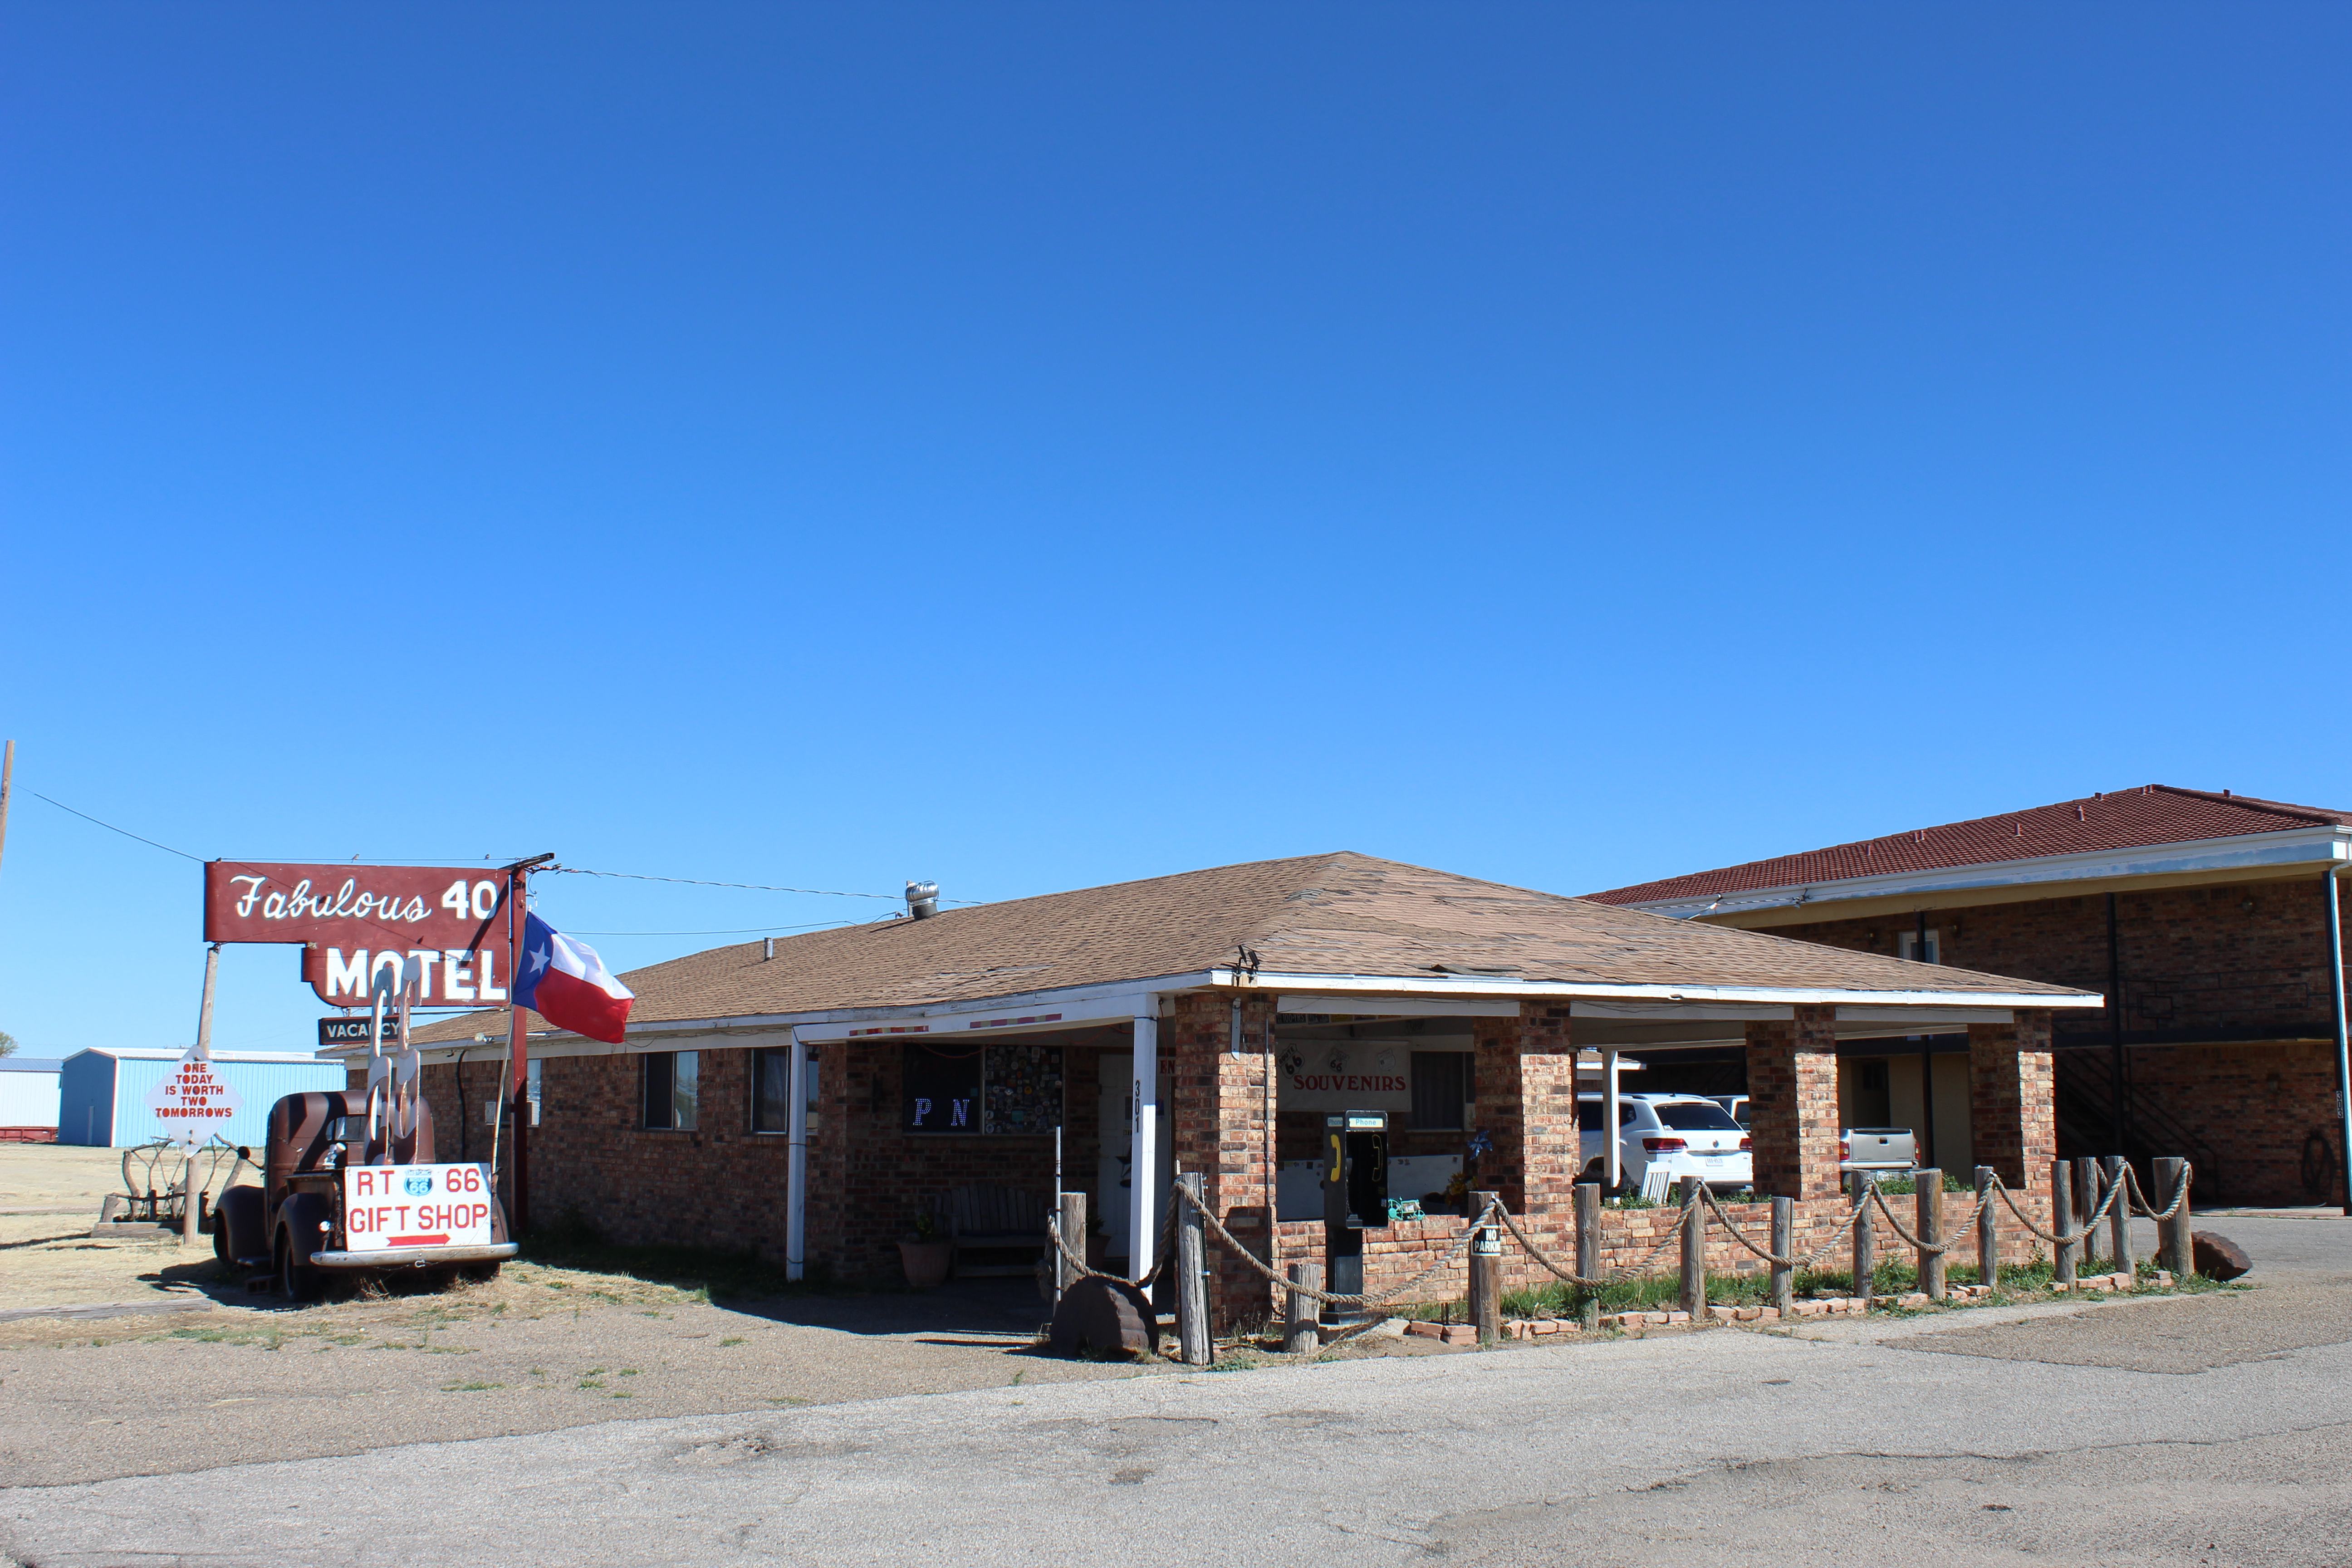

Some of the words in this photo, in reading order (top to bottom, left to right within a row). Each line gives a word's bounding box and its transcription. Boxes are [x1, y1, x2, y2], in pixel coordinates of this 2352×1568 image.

[230, 875, 431, 922] Fabulous
[441, 879, 498, 920] 40
[326, 948, 508, 1001] MOTEL
[327, 1022, 400, 1038] VACACY
[1278, 1046, 1294, 1064] ROUTE
[183, 1063, 207, 1073] ONE
[1285, 1055, 1302, 1075] 66
[1330, 1059, 1343, 1072] 66
[176, 1074, 214, 1084] TODAY
[1294, 1075, 1406, 1091] SOUVENIRS
[165, 1085, 177, 1095] IS
[182, 1085, 224, 1095] WORTH
[181, 1096, 207, 1106] TWO
[155, 1107, 233, 1117] TOMORROWS
[409, 1182, 429, 1193] 66
[446, 1168, 480, 1193] 66
[349, 1205, 411, 1233] GIFT
[418, 1203, 488, 1230] SHOP
[1486, 1229, 1497, 1241] NO
